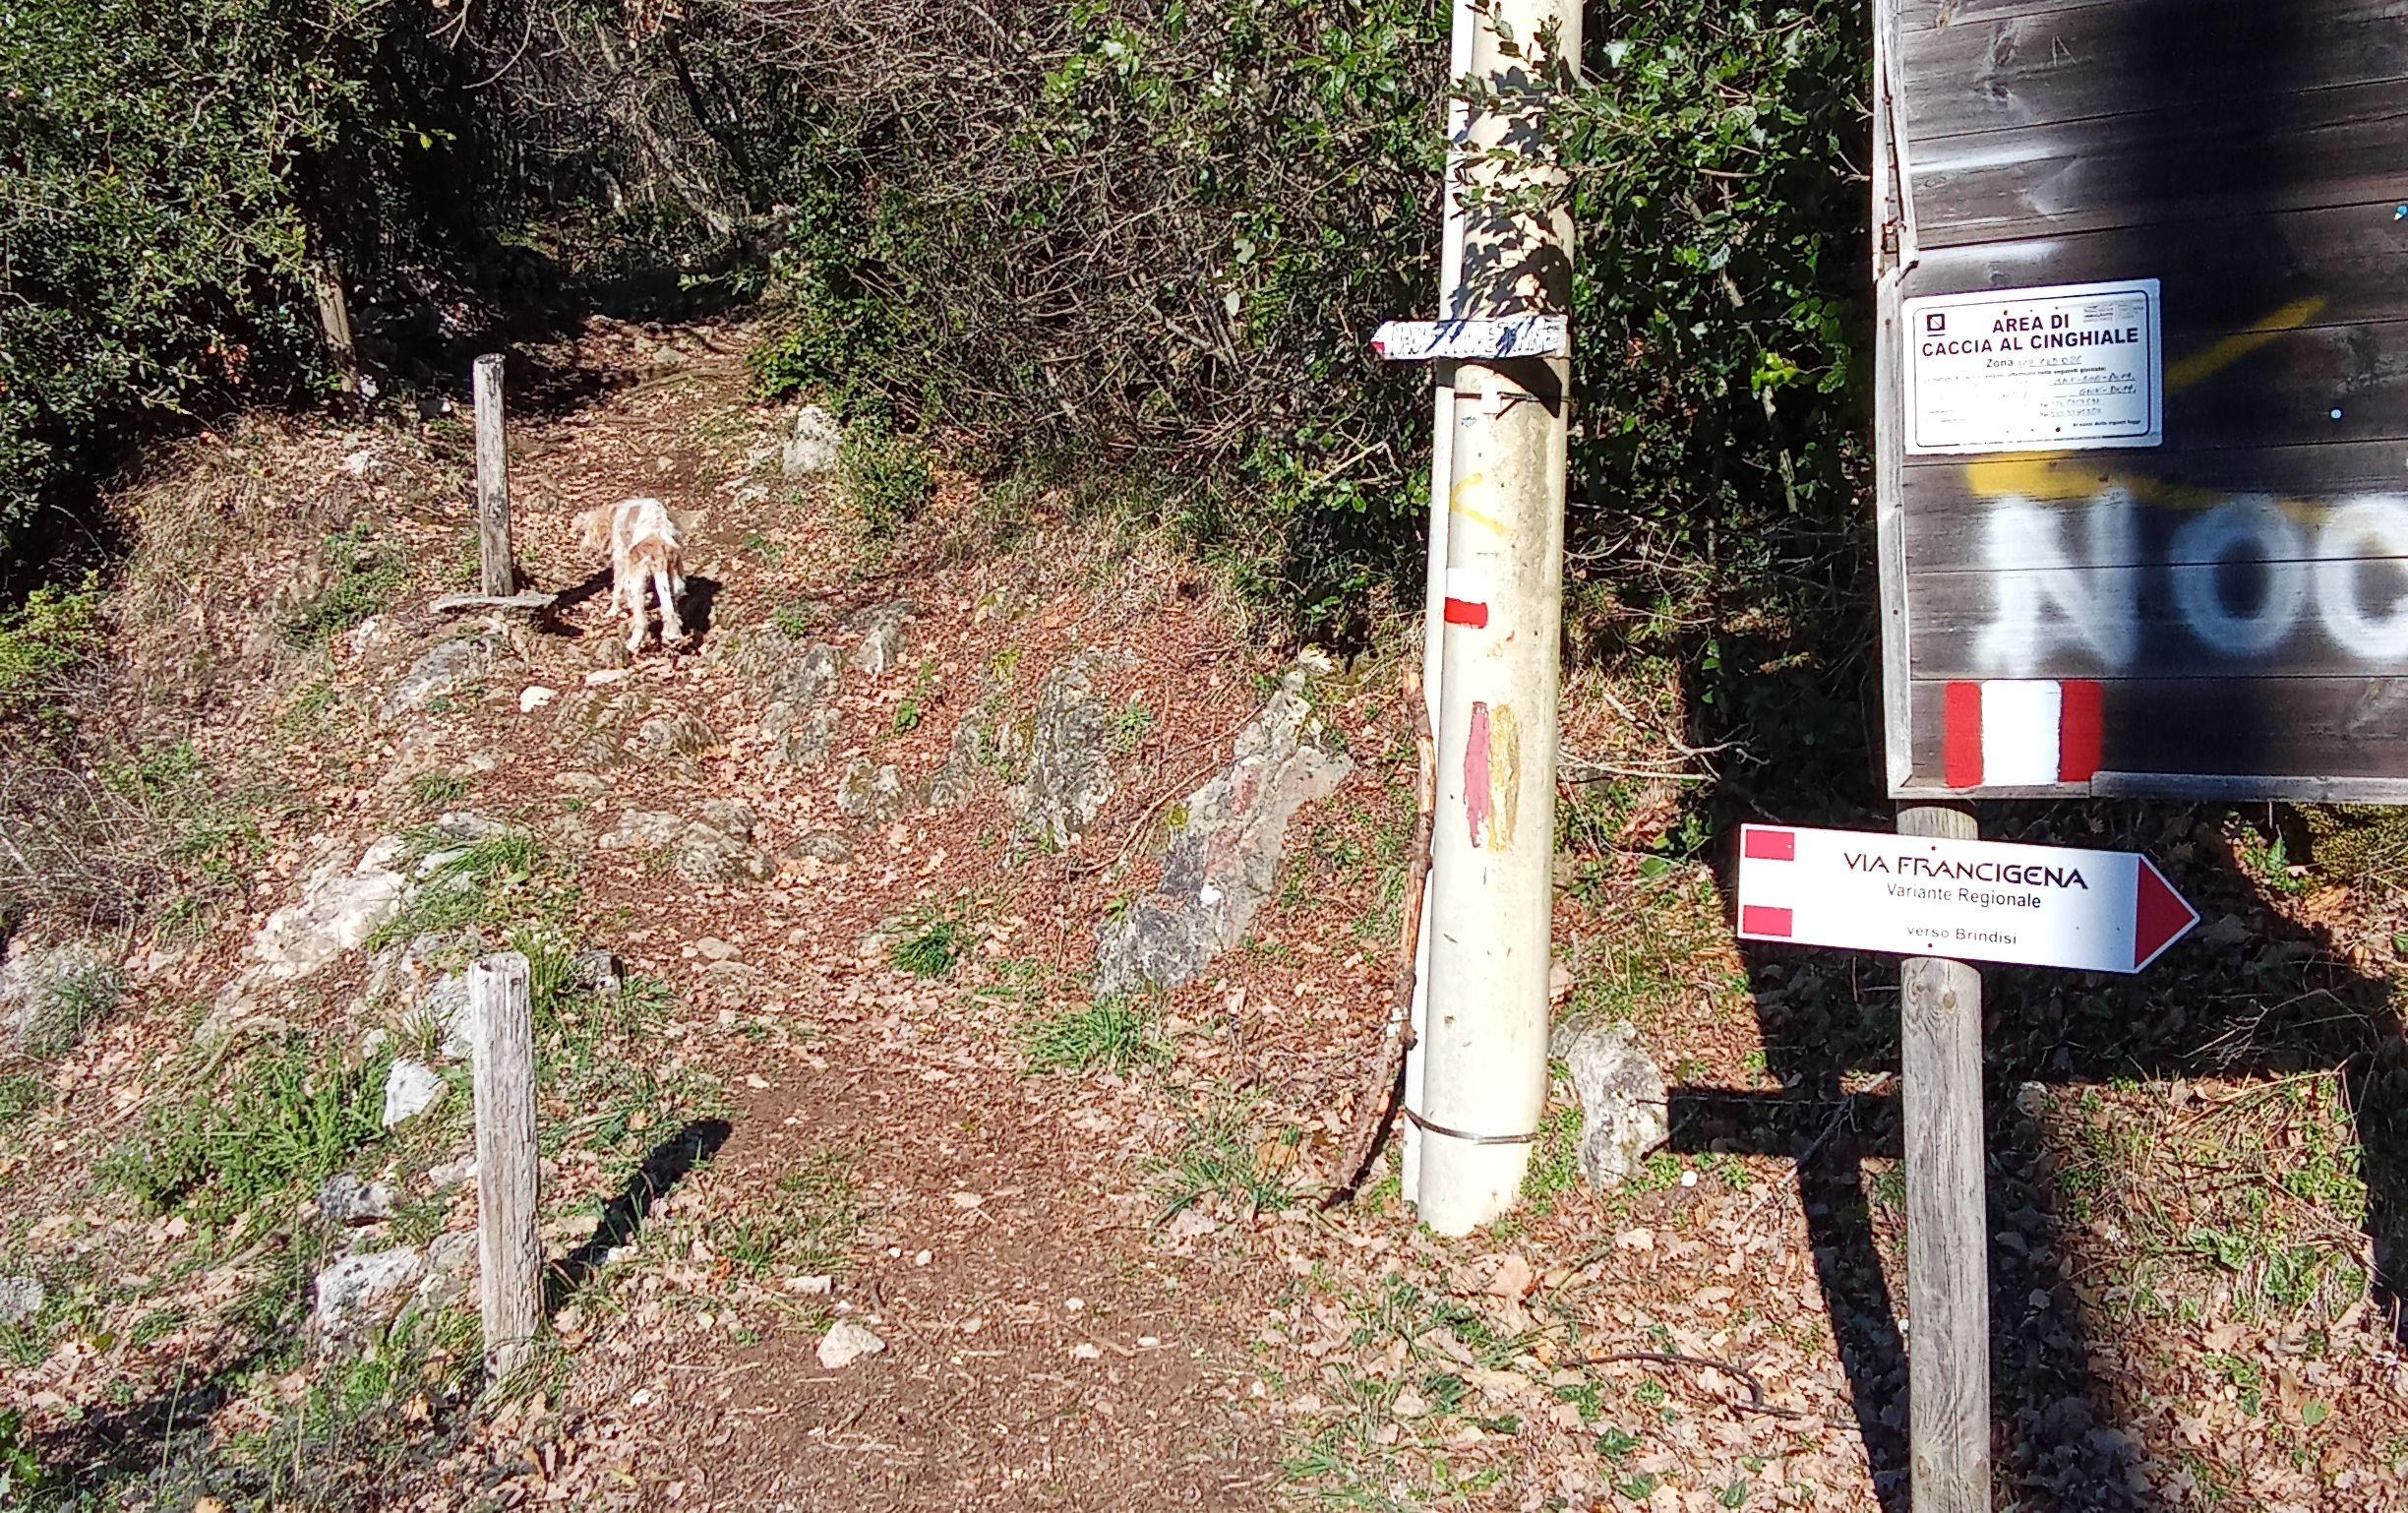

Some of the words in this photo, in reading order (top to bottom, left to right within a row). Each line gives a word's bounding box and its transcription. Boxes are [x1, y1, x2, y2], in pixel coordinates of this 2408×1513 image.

[1992, 316, 2044, 333] AREA
[2051, 313, 2070, 330] DI
[1922, 338, 1993, 357] CACCIA
[2000, 337, 2023, 352] AL
[2030, 327, 2139, 349] CINGHIALE
[1986, 358, 2014, 368] Zona
[1843, 852, 1890, 874] VIA
[1897, 856, 2088, 890] FRANCIGENA
[1887, 882, 1953, 901] Variante
[1958, 887, 2041, 908] Regionale
[1906, 927, 1950, 938] verso
[1956, 928, 2017, 944] Brindisi
